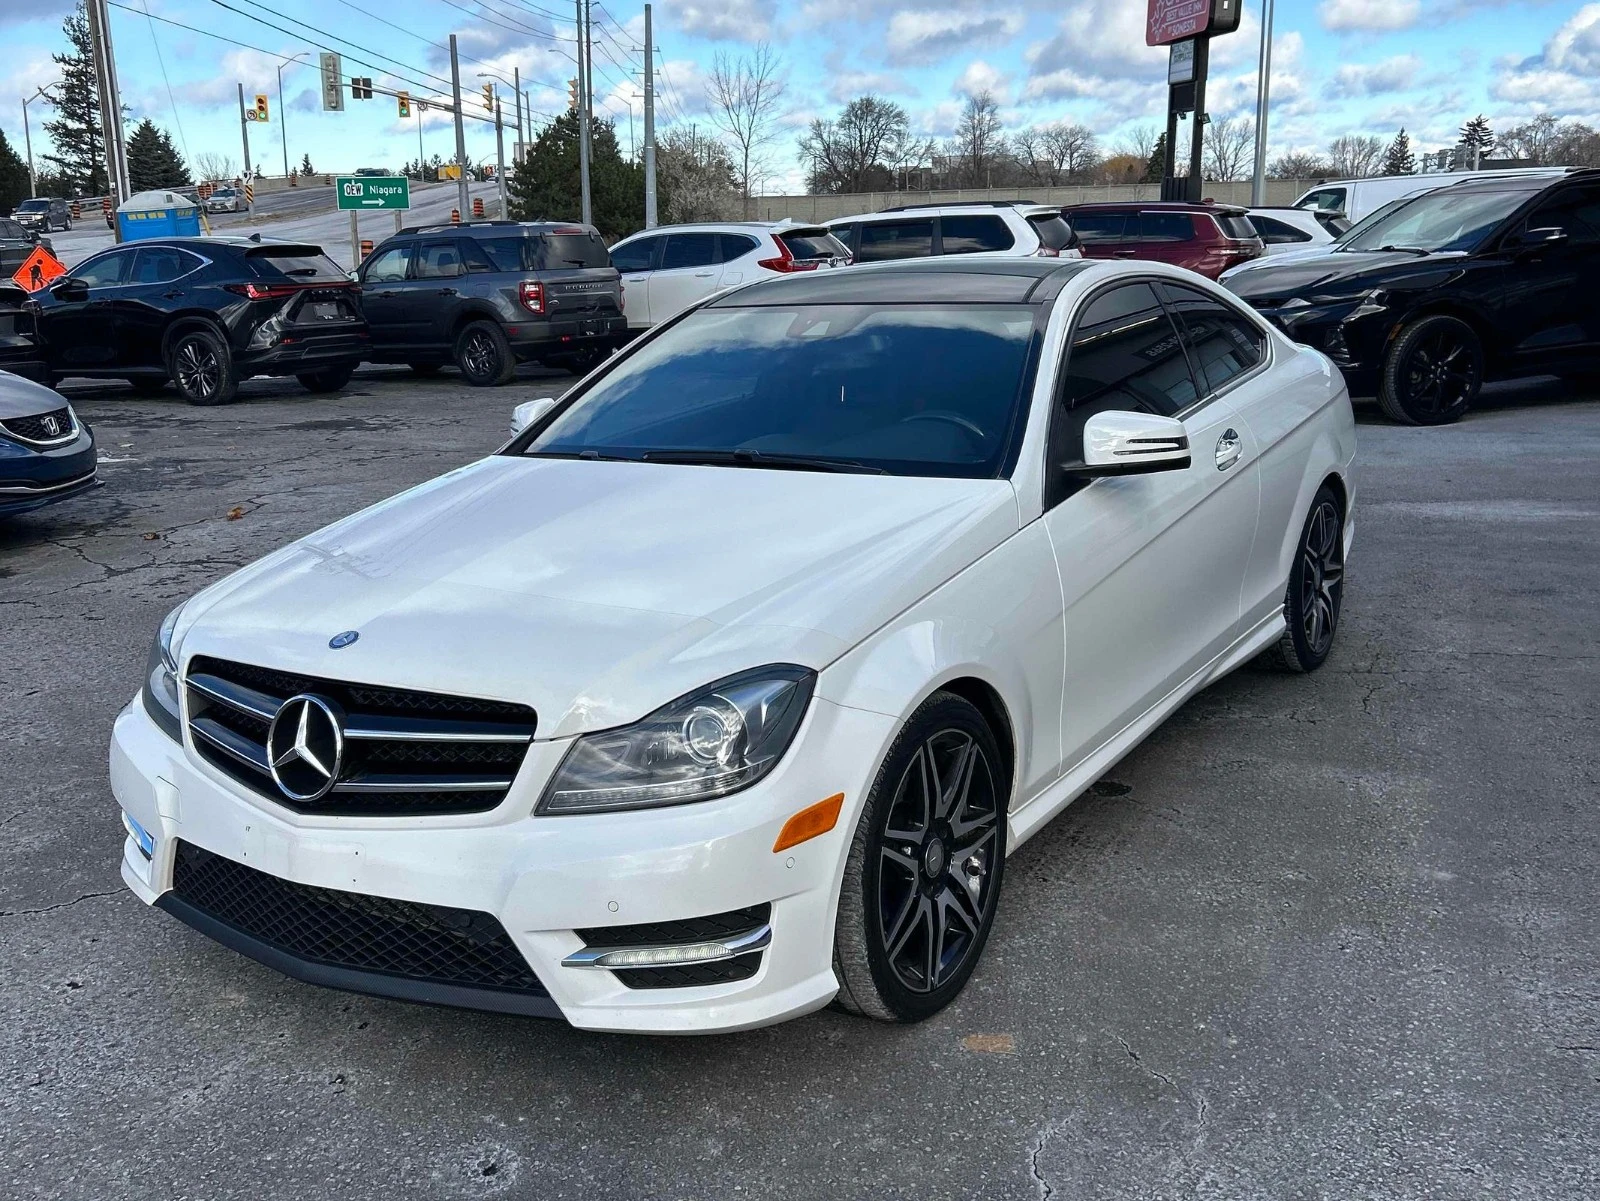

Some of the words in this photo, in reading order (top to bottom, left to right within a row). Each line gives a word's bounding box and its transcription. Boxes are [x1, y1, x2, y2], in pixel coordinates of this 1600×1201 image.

[1166, 9, 1178, 21] BEST
[1178, 4, 1192, 17] VALUE
[1172, 20, 1196, 36] SONESTA
[369, 185, 403, 196] Niagara
